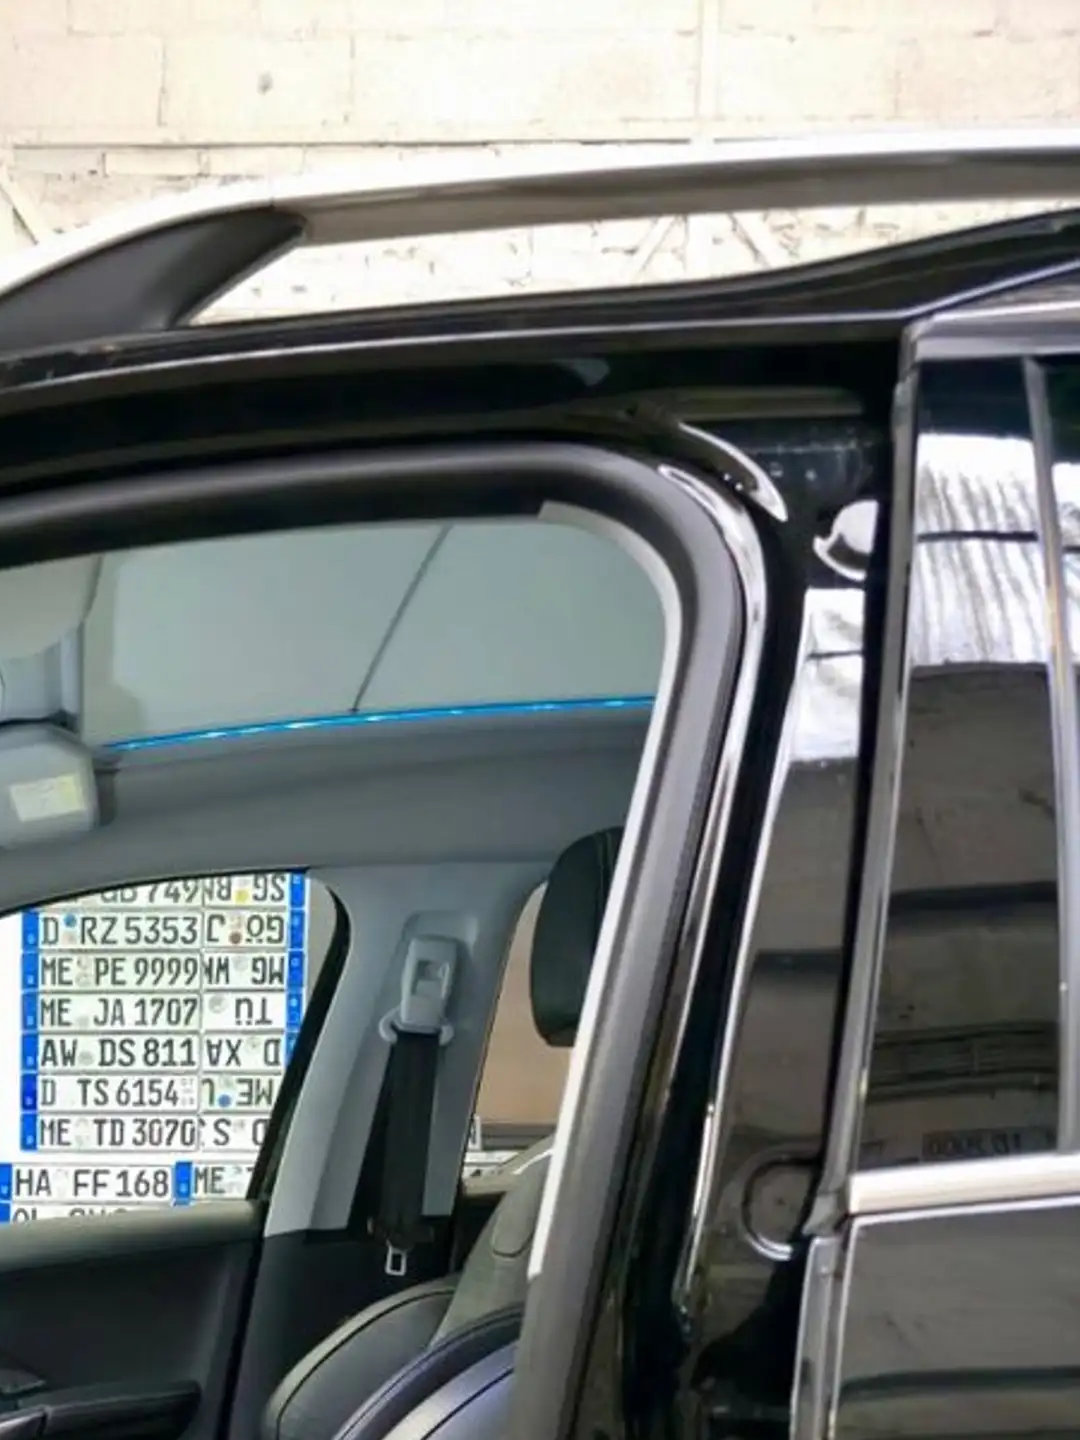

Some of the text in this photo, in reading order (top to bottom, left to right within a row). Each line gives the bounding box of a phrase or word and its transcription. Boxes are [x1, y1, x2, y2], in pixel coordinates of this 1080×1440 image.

[41, 916, 198, 945] D RZ 5353
[41, 957, 198, 986] ME PE 9999
[40, 998, 198, 1026] ME JA 1707
[41, 1037, 196, 1067] AW DS 811
[206, 1038, 241, 1067] XA
[41, 1079, 56, 1106] D
[77, 1078, 109, 1107] TS
[116, 1078, 179, 1107] 6154
[40, 1118, 197, 1146] ME TD 3070
[15, 1169, 169, 1197] HA FF 168
[194, 1166, 225, 1194] ME
